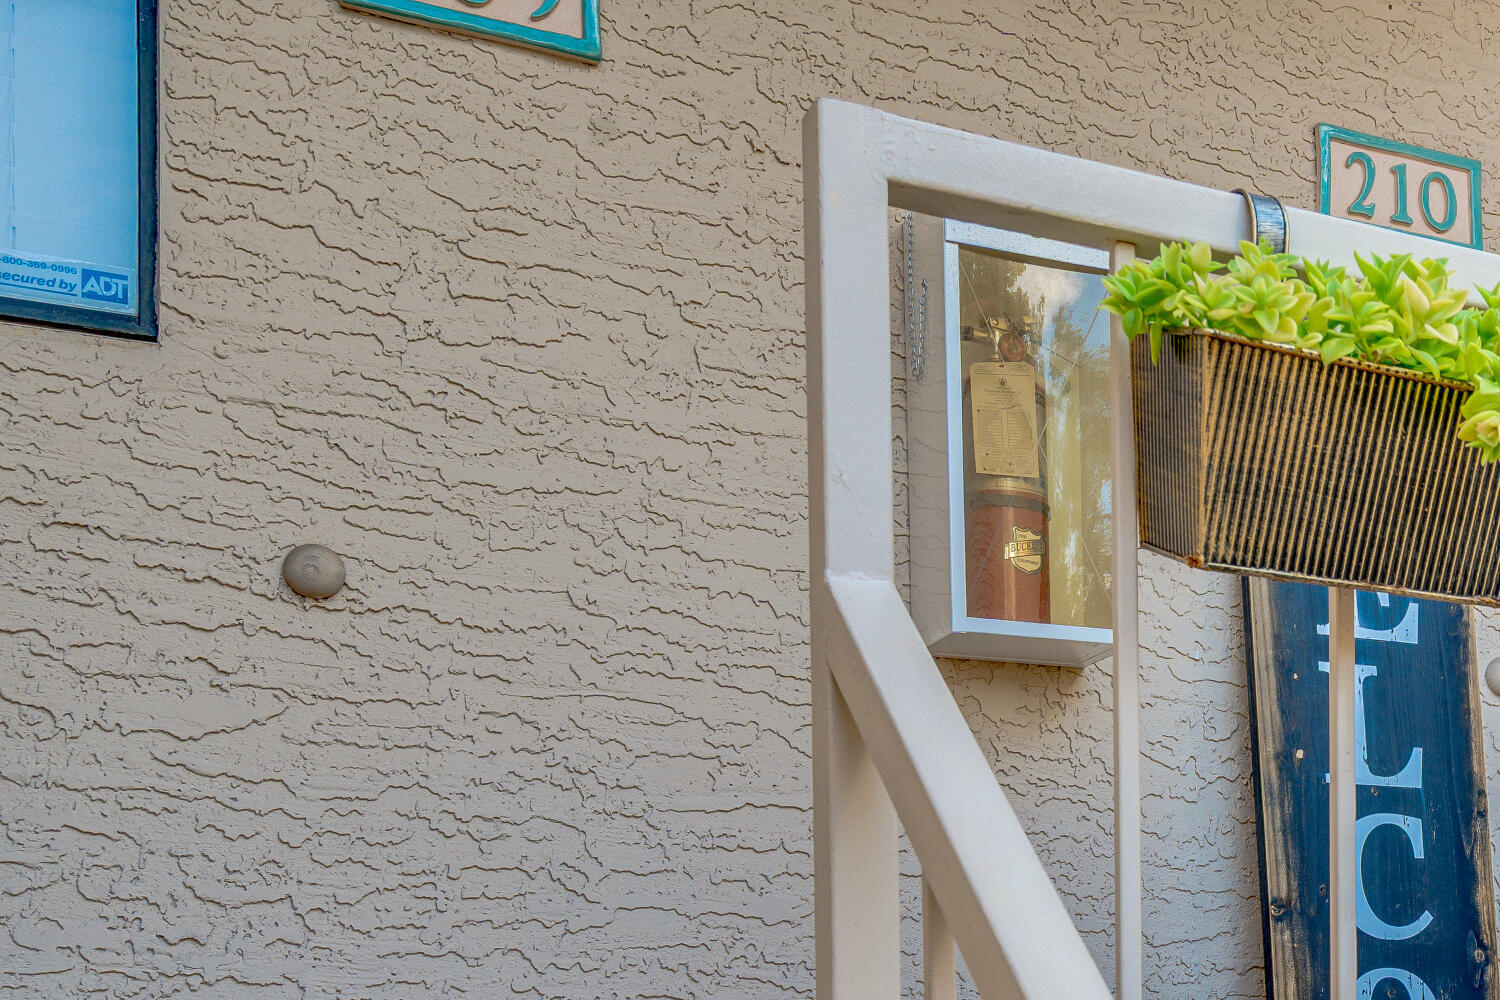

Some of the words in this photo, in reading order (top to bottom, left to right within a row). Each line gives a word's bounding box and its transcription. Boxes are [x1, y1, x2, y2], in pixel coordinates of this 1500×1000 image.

[1345, 151, 1458, 233] 210
[0, 271, 57, 288] ecured
[58, 278, 78, 292] by
[82, 274, 129, 300] ADT
